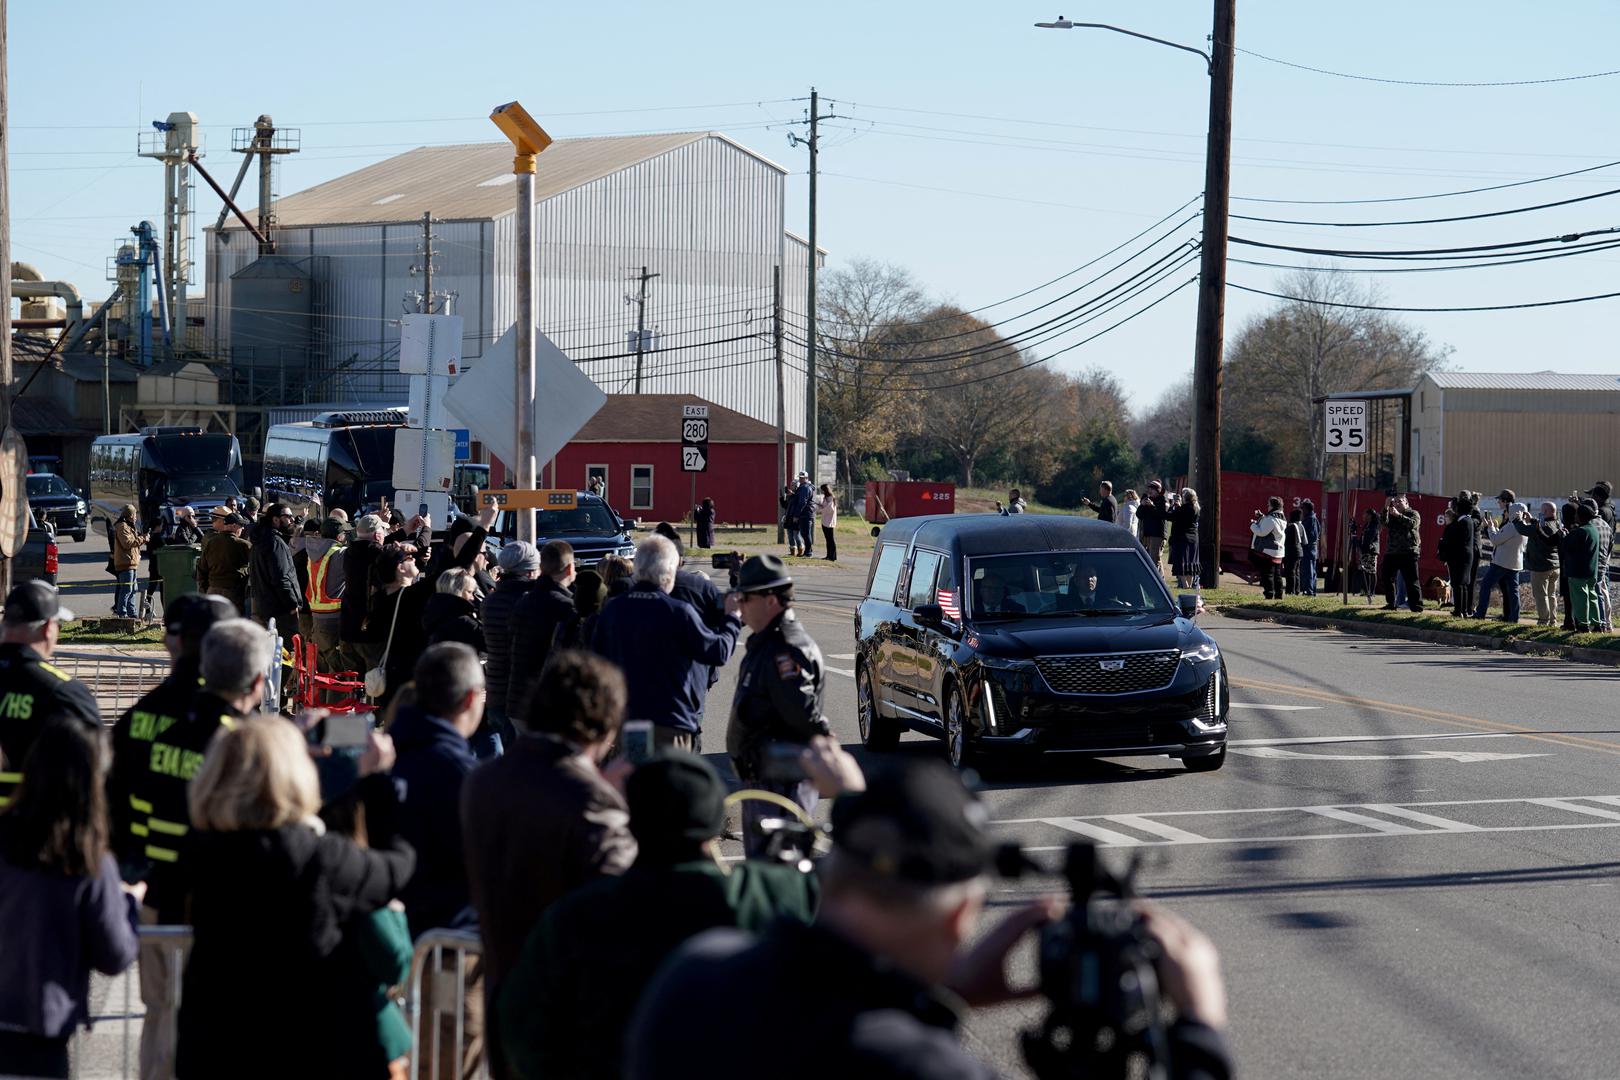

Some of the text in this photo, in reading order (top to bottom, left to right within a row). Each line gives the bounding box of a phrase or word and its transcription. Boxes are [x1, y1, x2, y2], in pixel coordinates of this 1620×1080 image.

[685, 406, 706, 416] EAST
[1328, 406, 1364, 415] SPEED
[1331, 417, 1360, 426] LIMIT
[685, 423, 705, 438] 280
[1328, 428, 1364, 447] 35
[685, 452, 699, 467] 27
